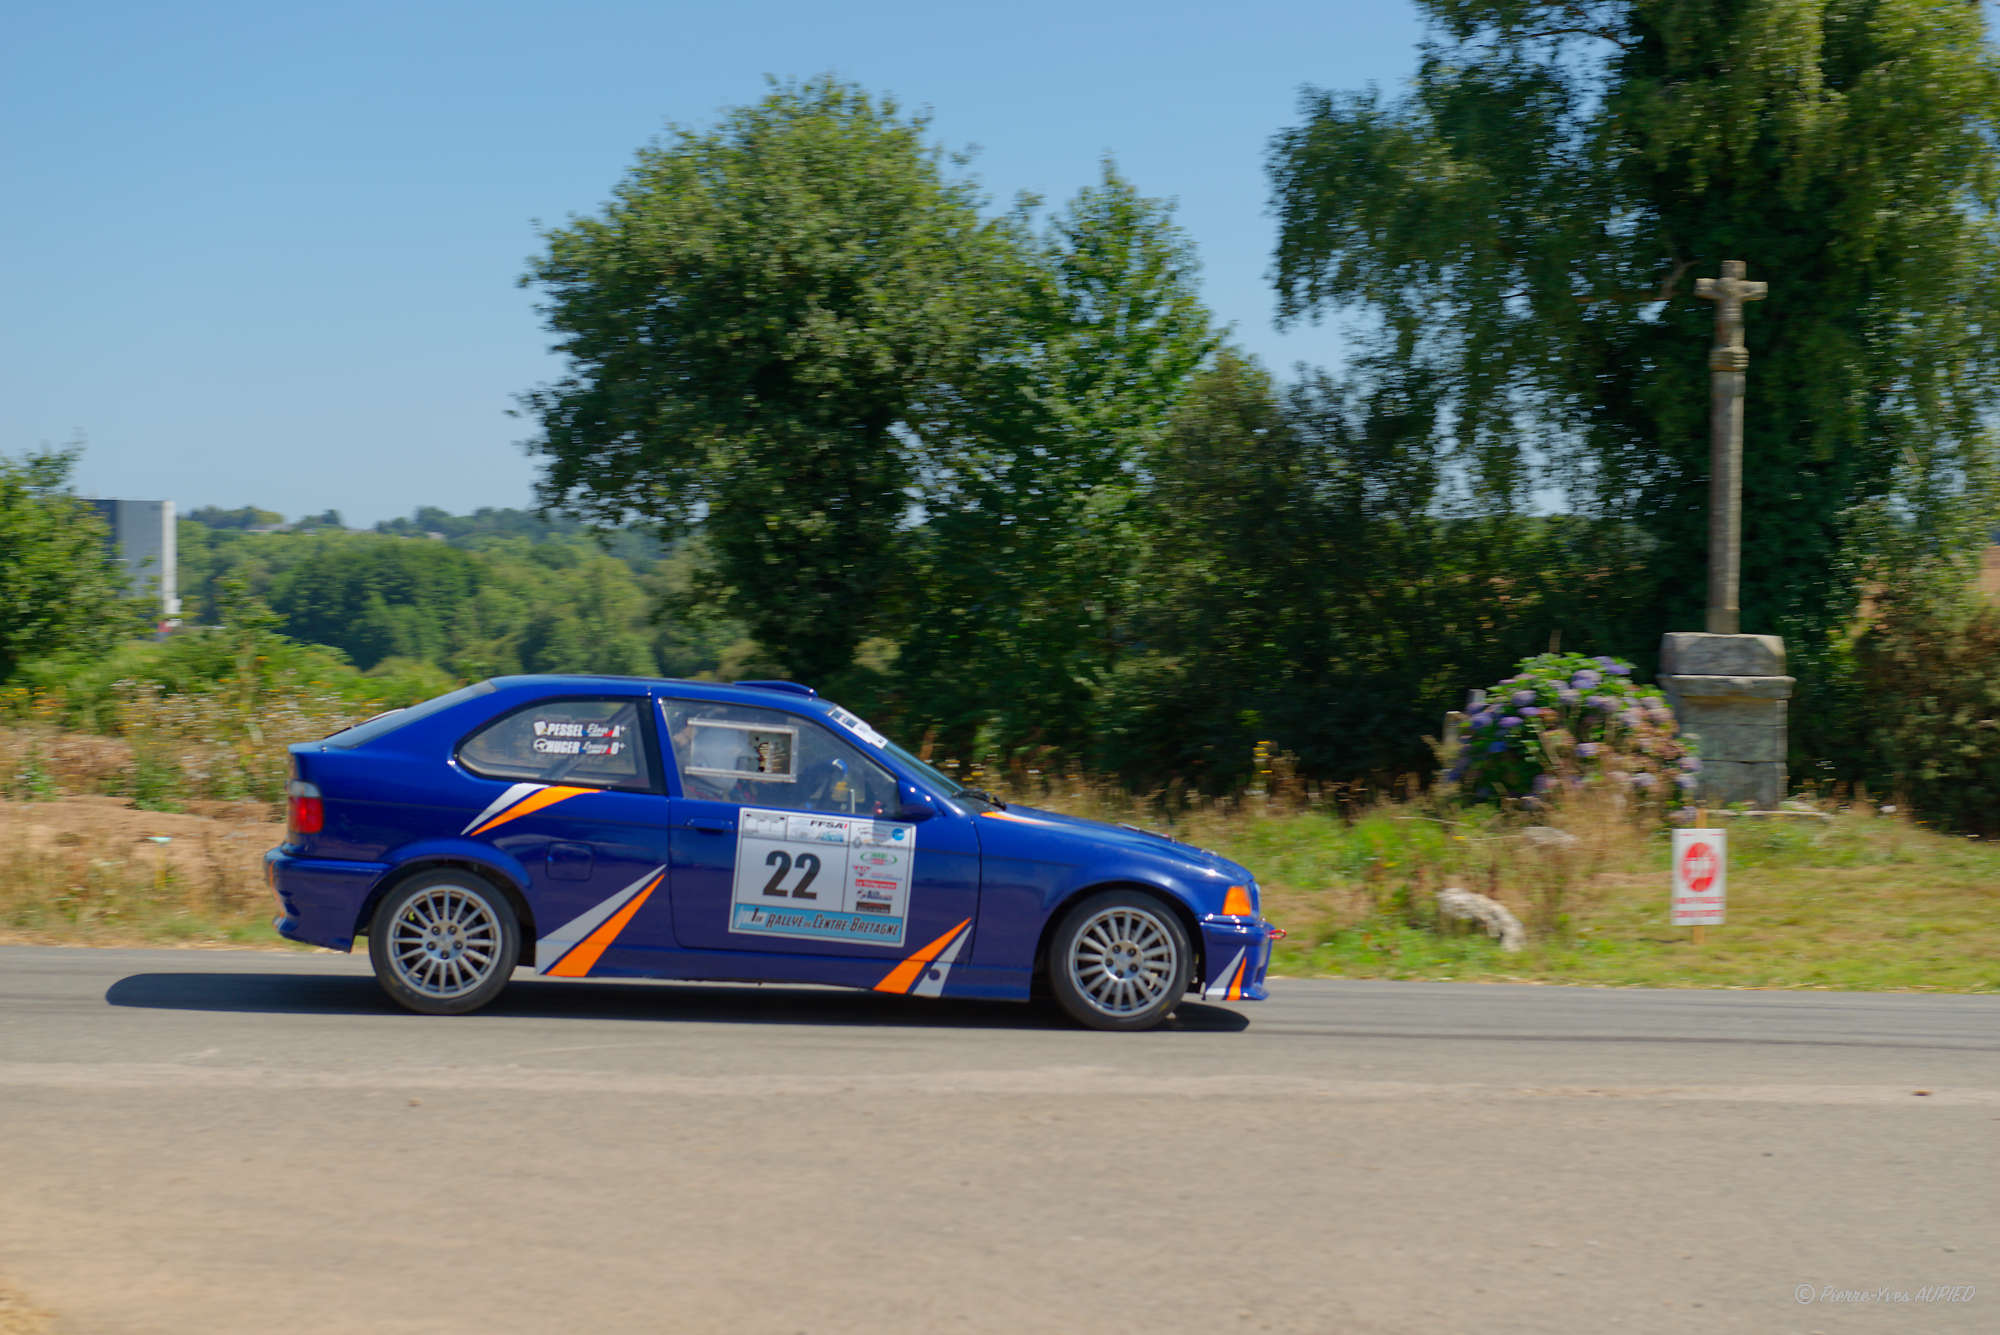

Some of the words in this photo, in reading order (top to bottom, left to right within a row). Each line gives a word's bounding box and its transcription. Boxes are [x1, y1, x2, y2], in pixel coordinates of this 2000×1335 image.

[547, 723, 583, 737] PESSEL
[810, 819, 844, 830] FFSA
[763, 849, 821, 900] 22
[766, 912, 805, 929] RALLYE
